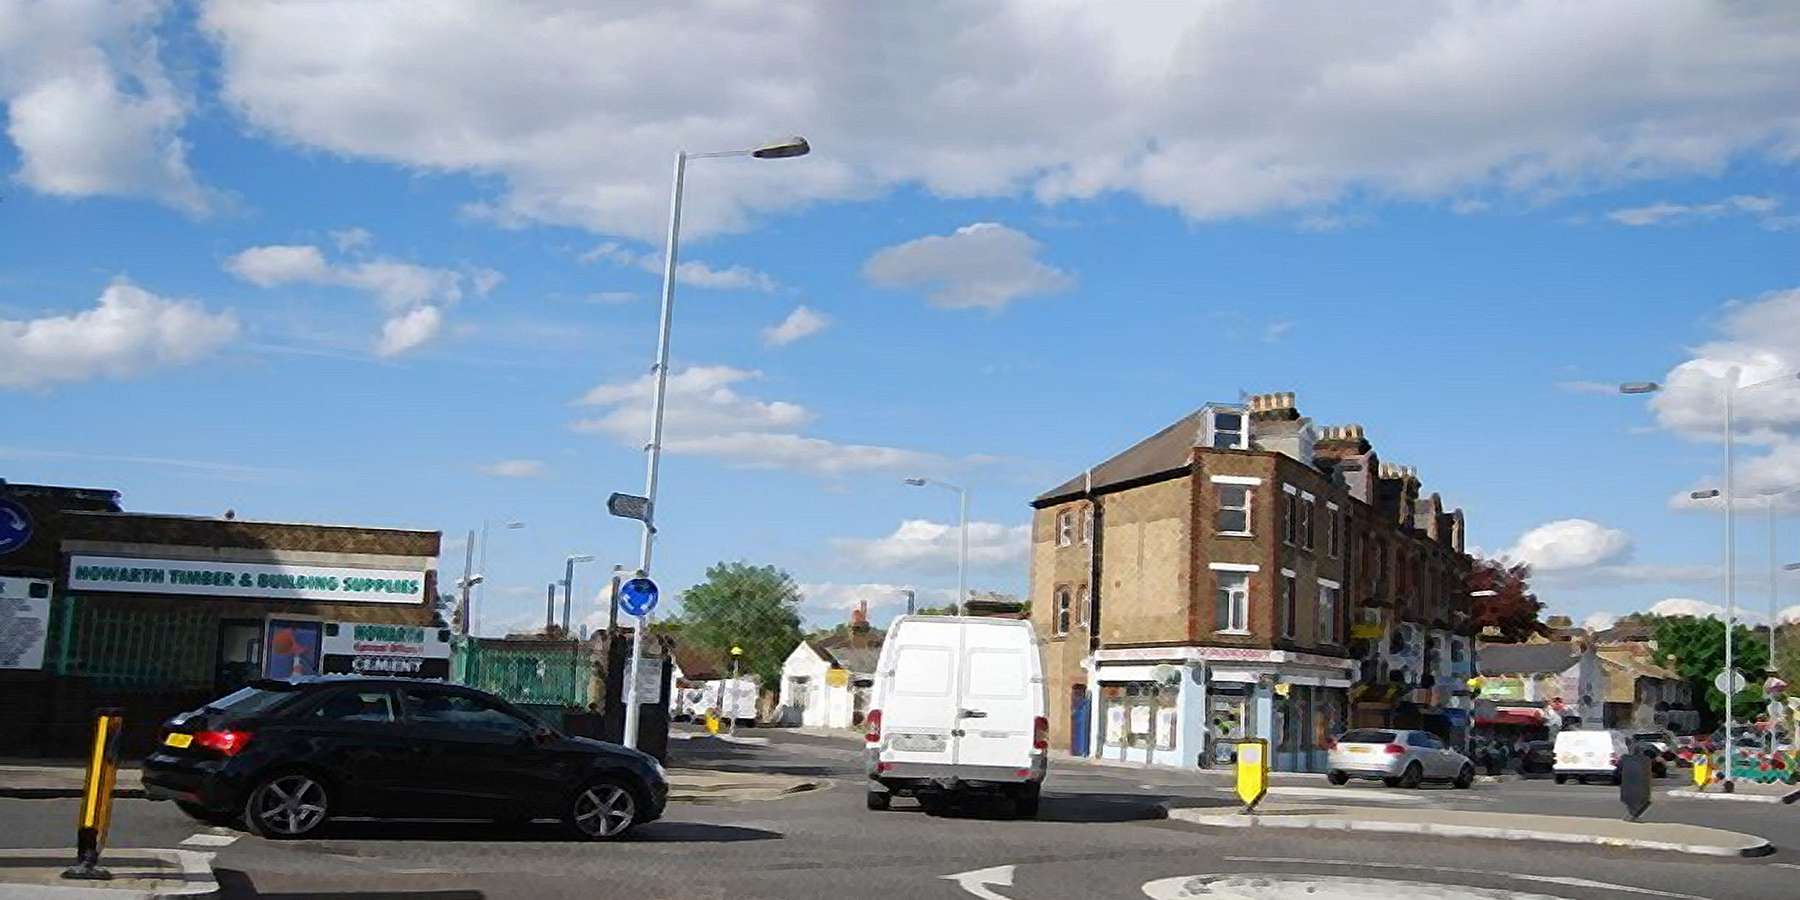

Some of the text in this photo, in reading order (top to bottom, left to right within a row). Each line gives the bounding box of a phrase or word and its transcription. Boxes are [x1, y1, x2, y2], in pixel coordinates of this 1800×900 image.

[75, 565, 419, 595] HOWARTH TIMBER & BUILDING SUPPLIES
